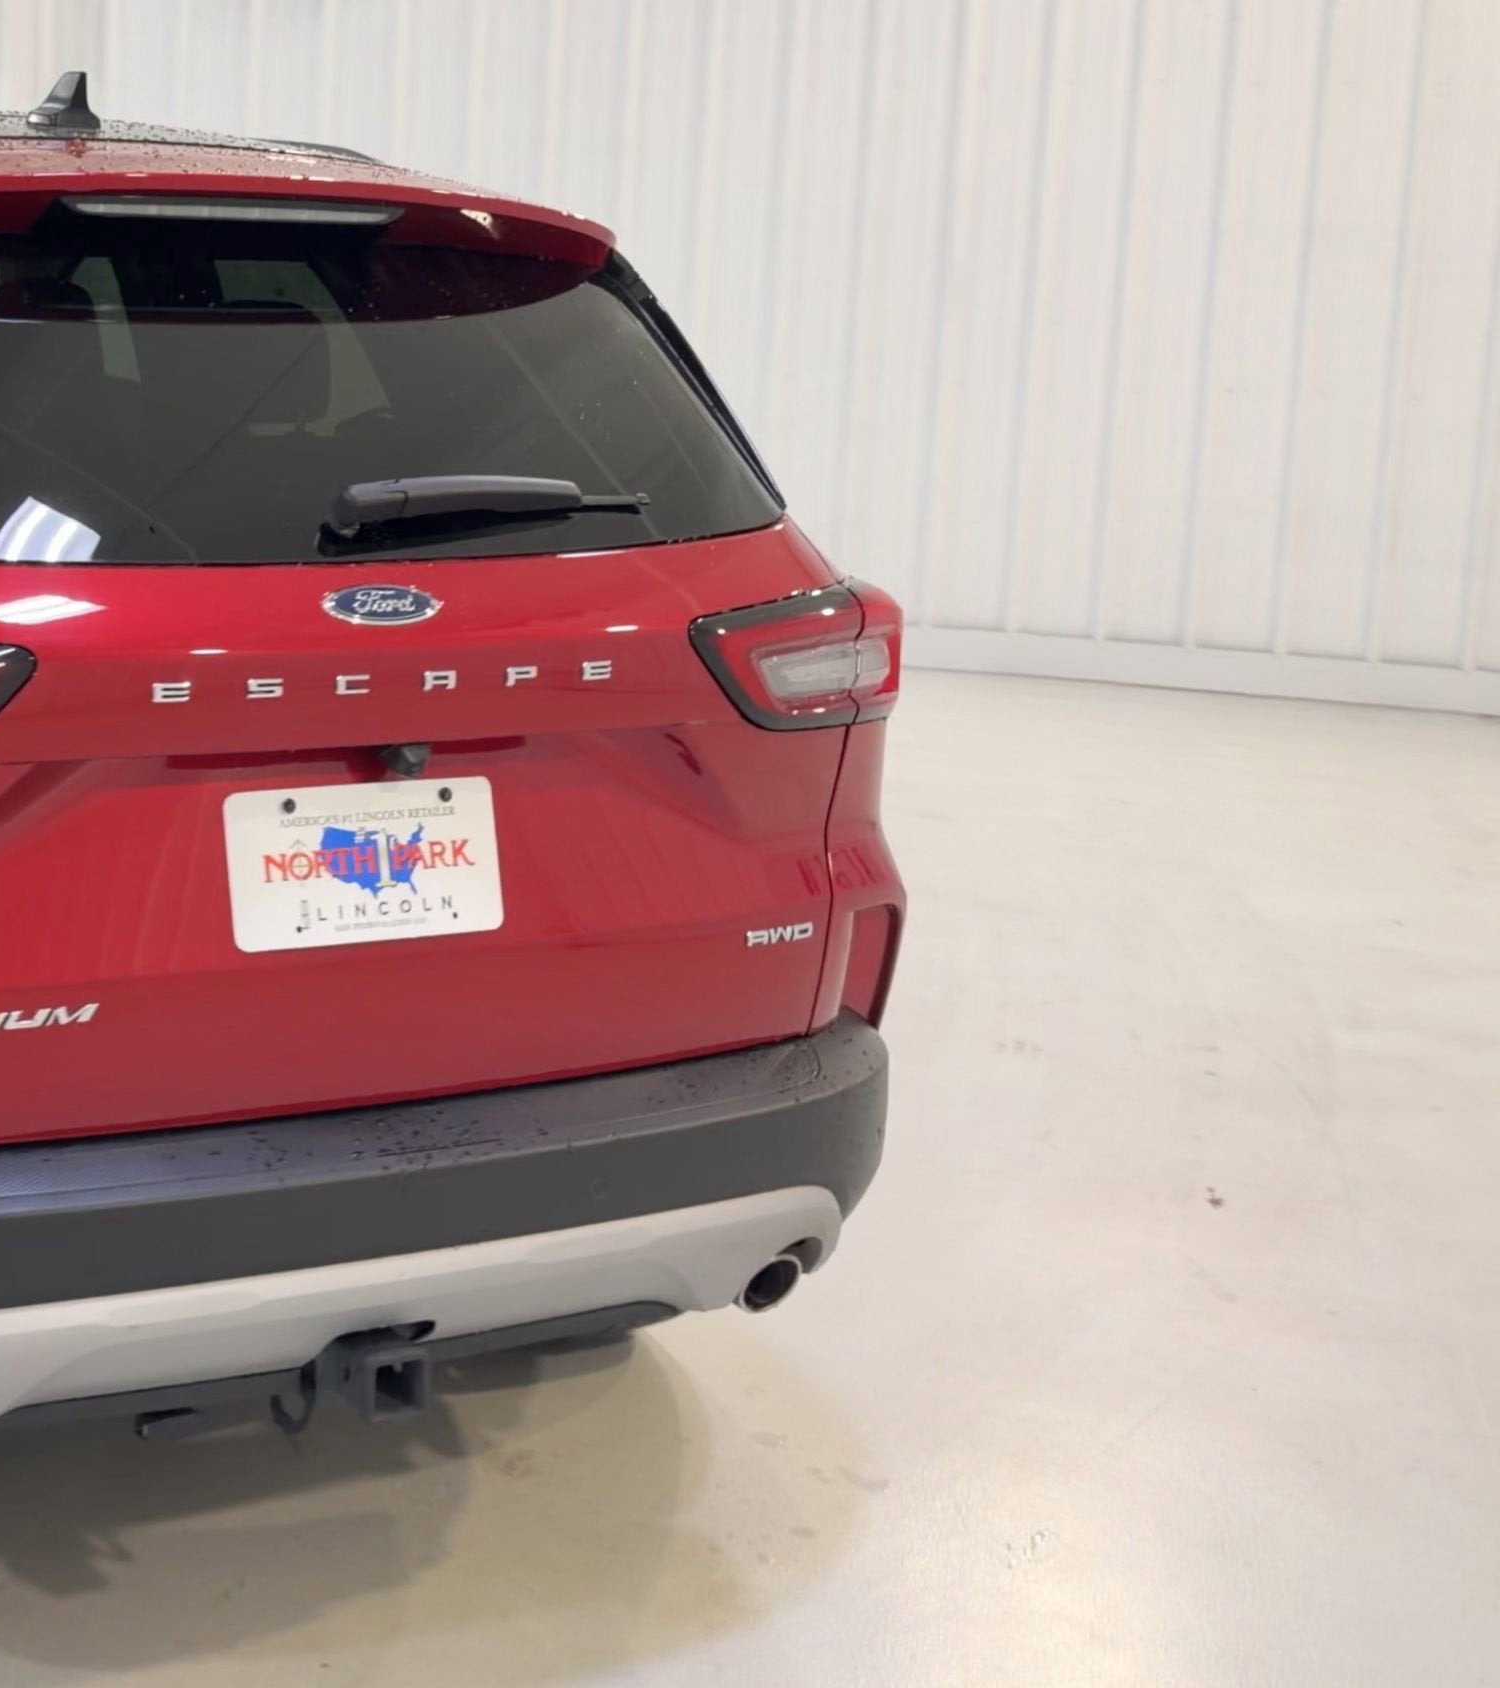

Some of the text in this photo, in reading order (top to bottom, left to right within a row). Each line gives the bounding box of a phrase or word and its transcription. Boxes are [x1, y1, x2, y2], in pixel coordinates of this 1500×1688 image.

[352, 589, 416, 614] Ford
[151, 659, 613, 703] ESCAPE
[355, 808, 405, 823] LINCOLN
[262, 838, 476, 883] NORTH PARK
[316, 896, 453, 922] LINCOLN
[746, 921, 814, 947] AWD
